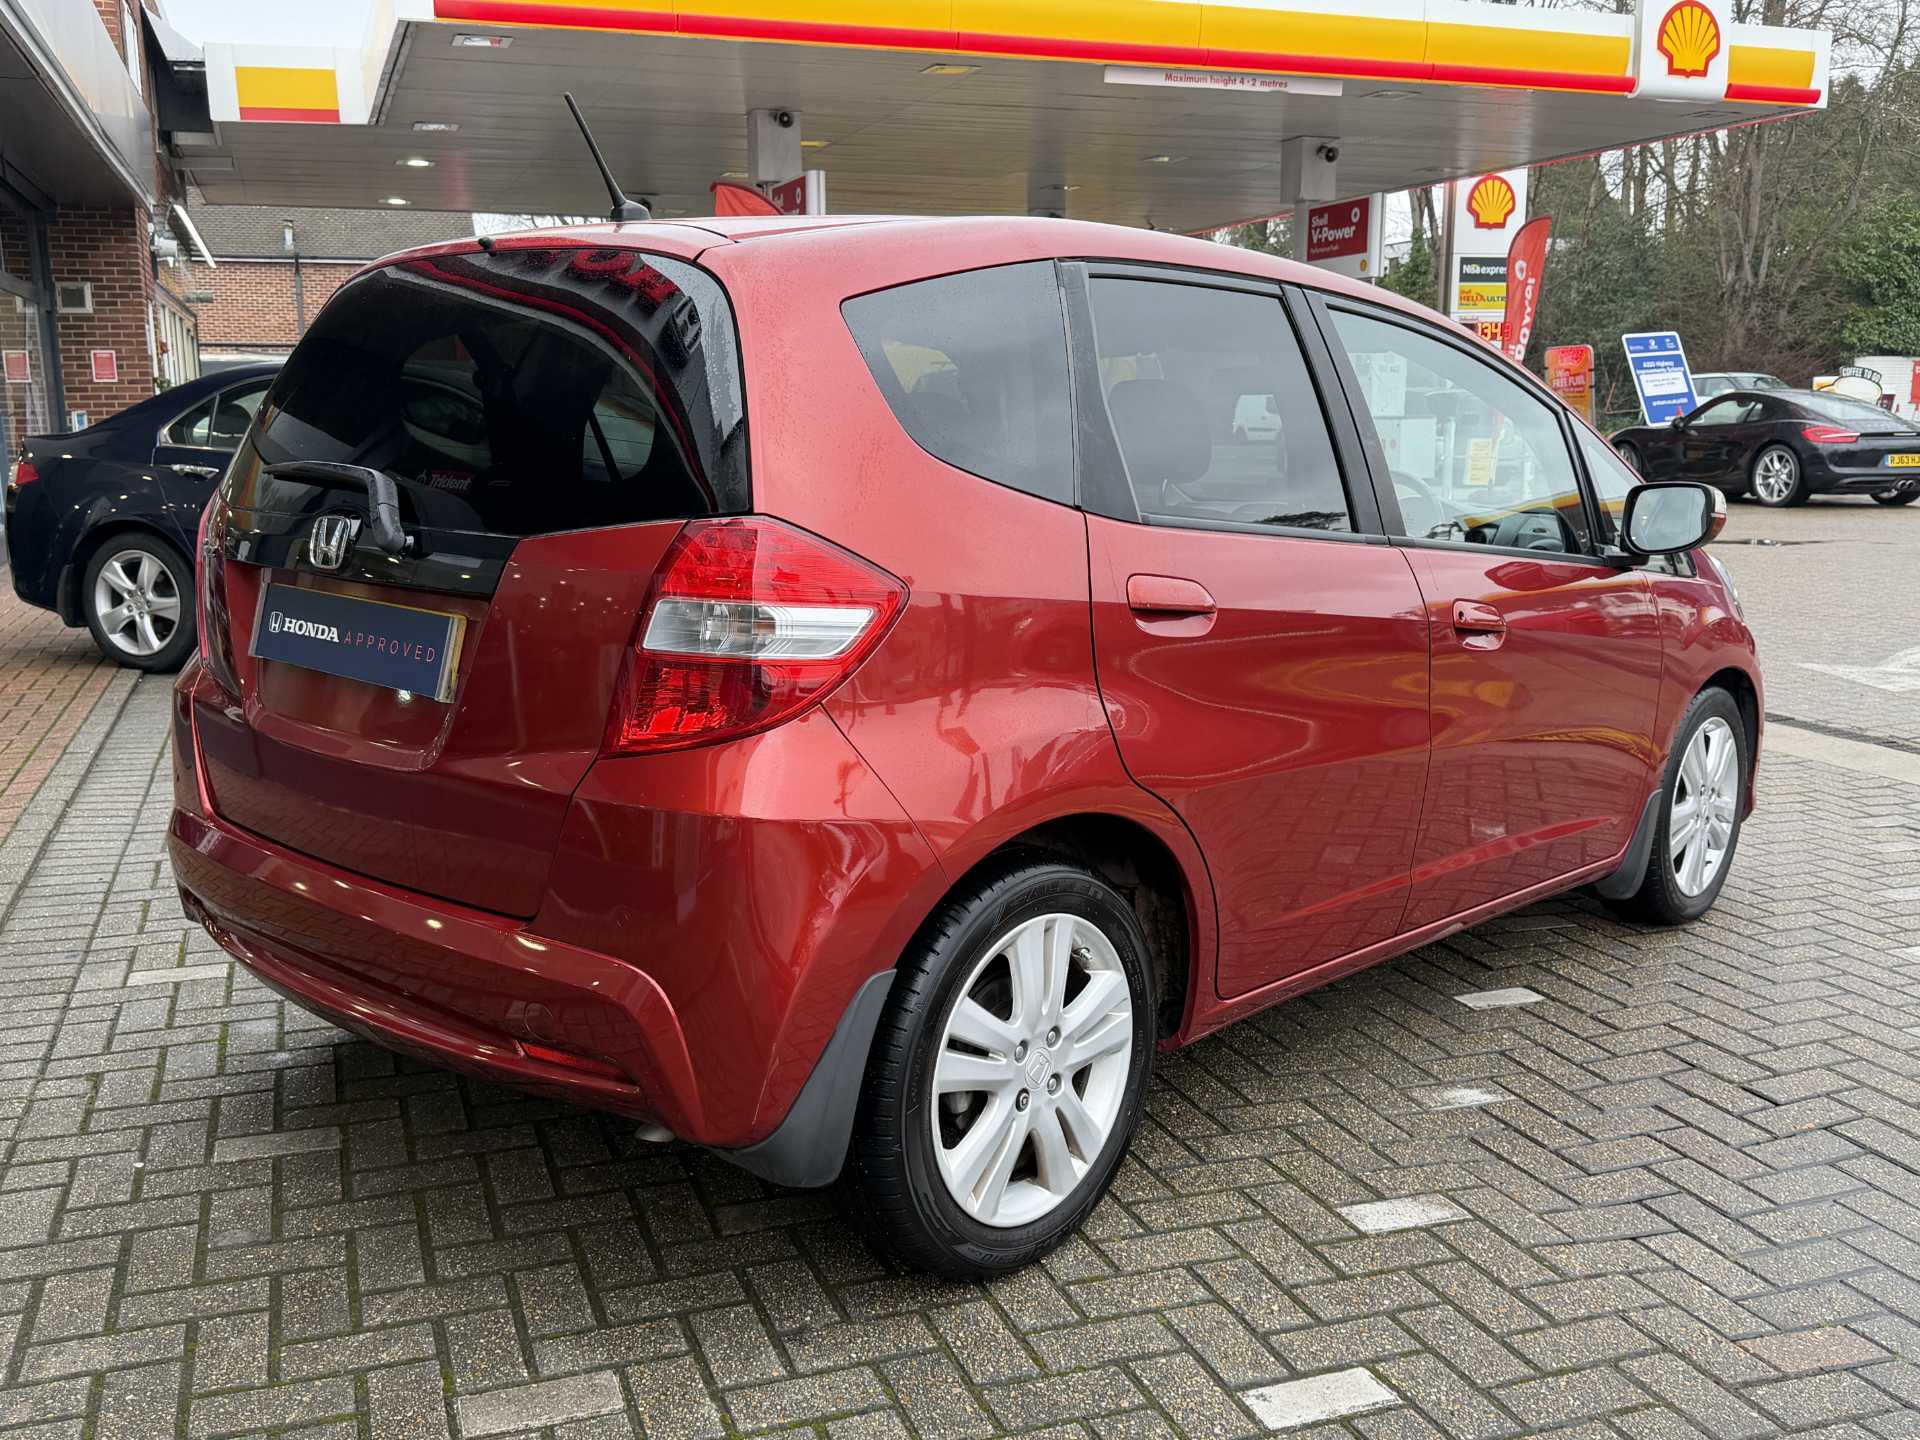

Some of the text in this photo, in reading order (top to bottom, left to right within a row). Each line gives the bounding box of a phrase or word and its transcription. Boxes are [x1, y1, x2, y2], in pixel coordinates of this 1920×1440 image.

[1164, 72, 1208, 84] Maximum
[1209, 74, 1237, 87] height
[1259, 79, 1288, 89] metres
[1311, 212, 1329, 228] Shell
[1311, 225, 1356, 245] V-Power
[1486, 295, 1506, 303] ULTR
[1842, 366, 1881, 383] COFFEE TO GO
[283, 617, 437, 663] HONDA APPROVED
